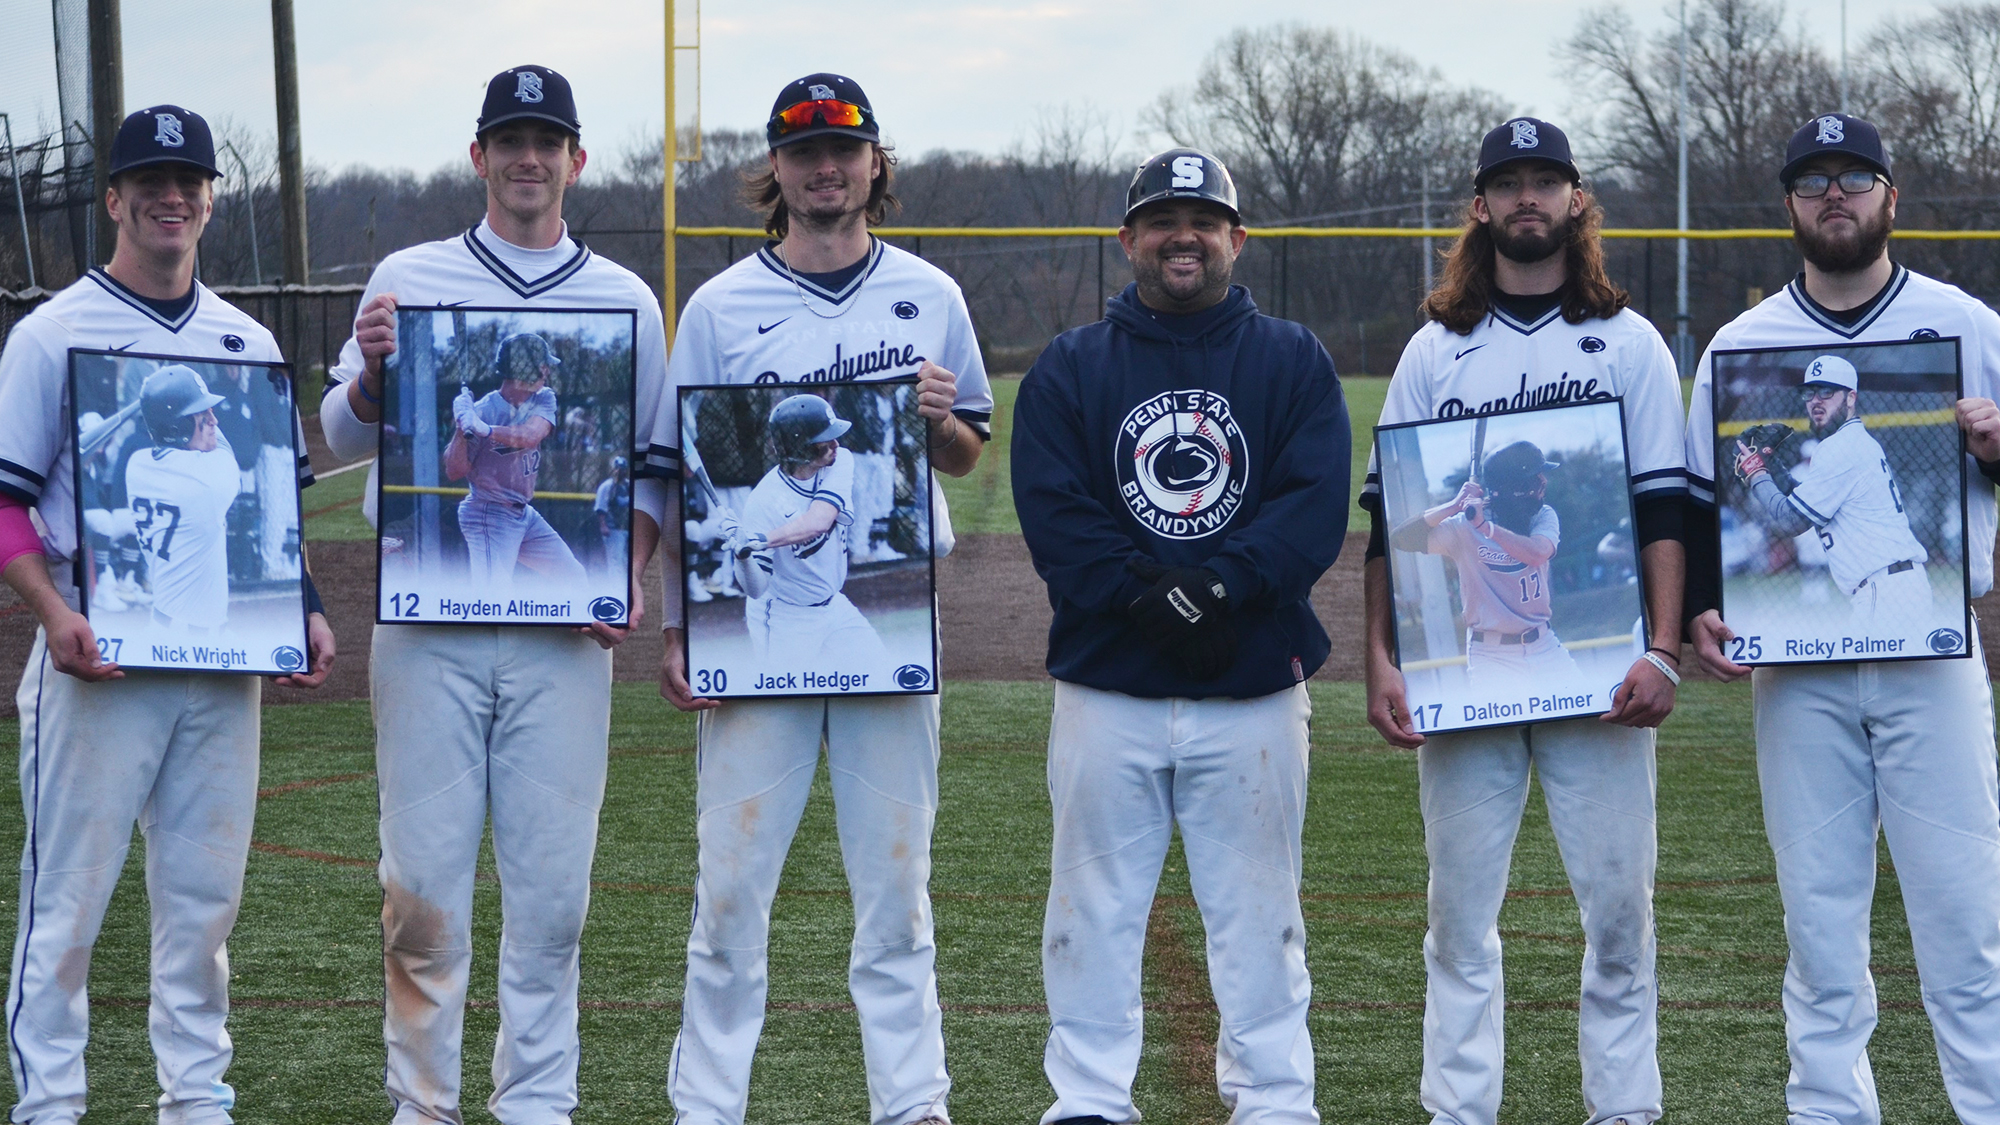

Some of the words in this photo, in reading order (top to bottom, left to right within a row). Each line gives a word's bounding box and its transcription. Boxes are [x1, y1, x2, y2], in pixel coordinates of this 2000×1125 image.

[1172, 156, 1204, 189] S
[1125, 396, 1179, 439] PENN
[1186, 394, 1237, 438] STATE
[522, 450, 540, 476] 12
[1122, 479, 1241, 535] BRANDYWINE
[132, 496, 182, 562] 27
[1519, 571, 1541, 602] 17
[390, 592, 420, 617] 12
[440, 599, 501, 620] Hayden
[506, 600, 570, 617] Altimari
[96, 637, 123, 662] 27
[152, 645, 188, 662] Nick
[193, 647, 247, 668] Wright
[1731, 636, 1762, 661] 25
[1786, 639, 1836, 659] Ricky
[1842, 636, 1905, 654] Palmer
[697, 669, 727, 694] 30
[754, 672, 797, 690] Jack
[803, 671, 869, 691] Hedger
[1413, 703, 1443, 730] 17
[1463, 701, 1523, 722] Dalton
[1529, 693, 1593, 714] Palmer
